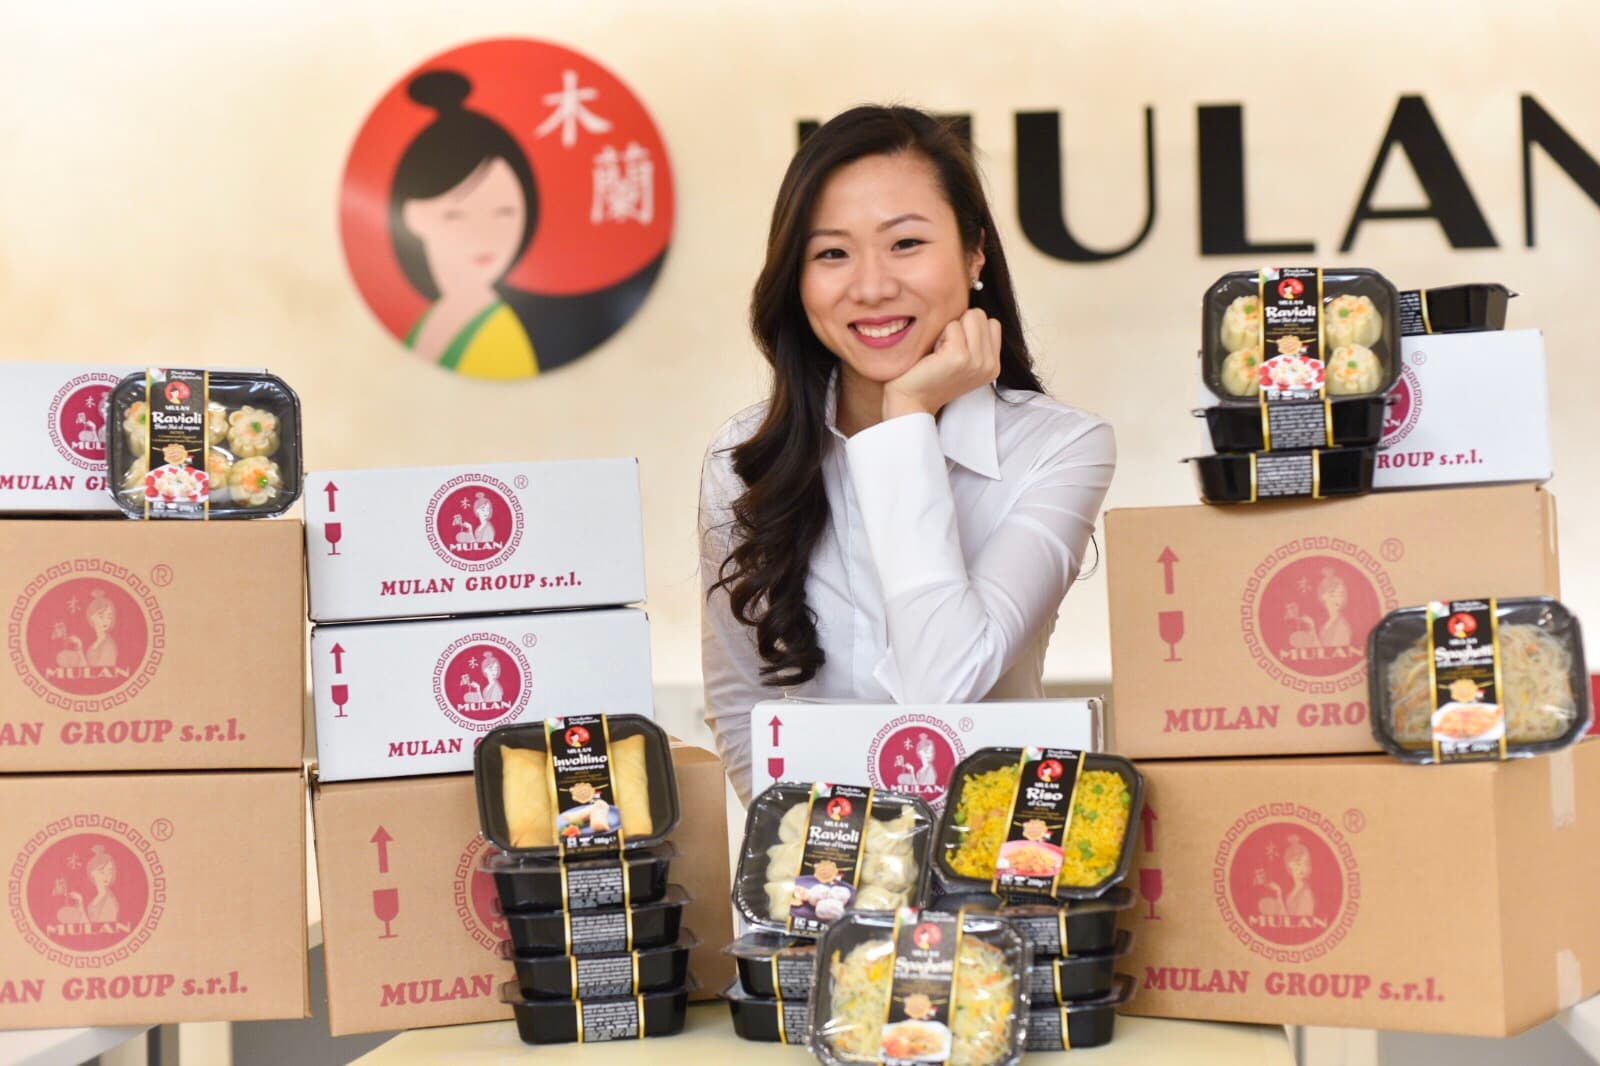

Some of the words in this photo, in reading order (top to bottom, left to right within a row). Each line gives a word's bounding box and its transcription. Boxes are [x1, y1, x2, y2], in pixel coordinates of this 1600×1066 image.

[797, 93, 1600, 263] ULAN
[1265, 305, 1316, 318] Ravioli
[152, 411, 202, 424] Ravioli
[72, 441, 106, 450] MUL
[1377, 451, 1434, 469] ROUP
[1439, 448, 1483, 465] s.r.l.
[0, 475, 75, 490] MULAN
[449, 541, 503, 552] MULAN
[380, 578, 455, 596] MULAN
[465, 574, 535, 592] GROUP
[540, 572, 582, 588] s.r.l.
[1280, 645, 1365, 661] MULAN
[45, 666, 130, 680] MULAN
[457, 700, 512, 711] MULAN
[1163, 705, 1280, 733] MULAN
[1296, 702, 1366, 727] GRO
[60, 719, 173, 745] GROUP
[180, 717, 246, 742] s.r.l.
[388, 738, 463, 758] MULAN
[553, 753, 608, 767] Involtino
[1026, 787, 1063, 801] Riso
[809, 825, 860, 843] Ravioli
[46, 921, 131, 936] MULAN
[1248, 915, 1328, 929] MULAN
[61, 973, 175, 1001] GROUP
[182, 971, 248, 996] s.r.l.
[380, 974, 495, 1007] MULAN
[1143, 966, 1249, 993] MULAN
[1264, 971, 1371, 999] GROUP
[1378, 976, 1445, 1002] s.r.l.
